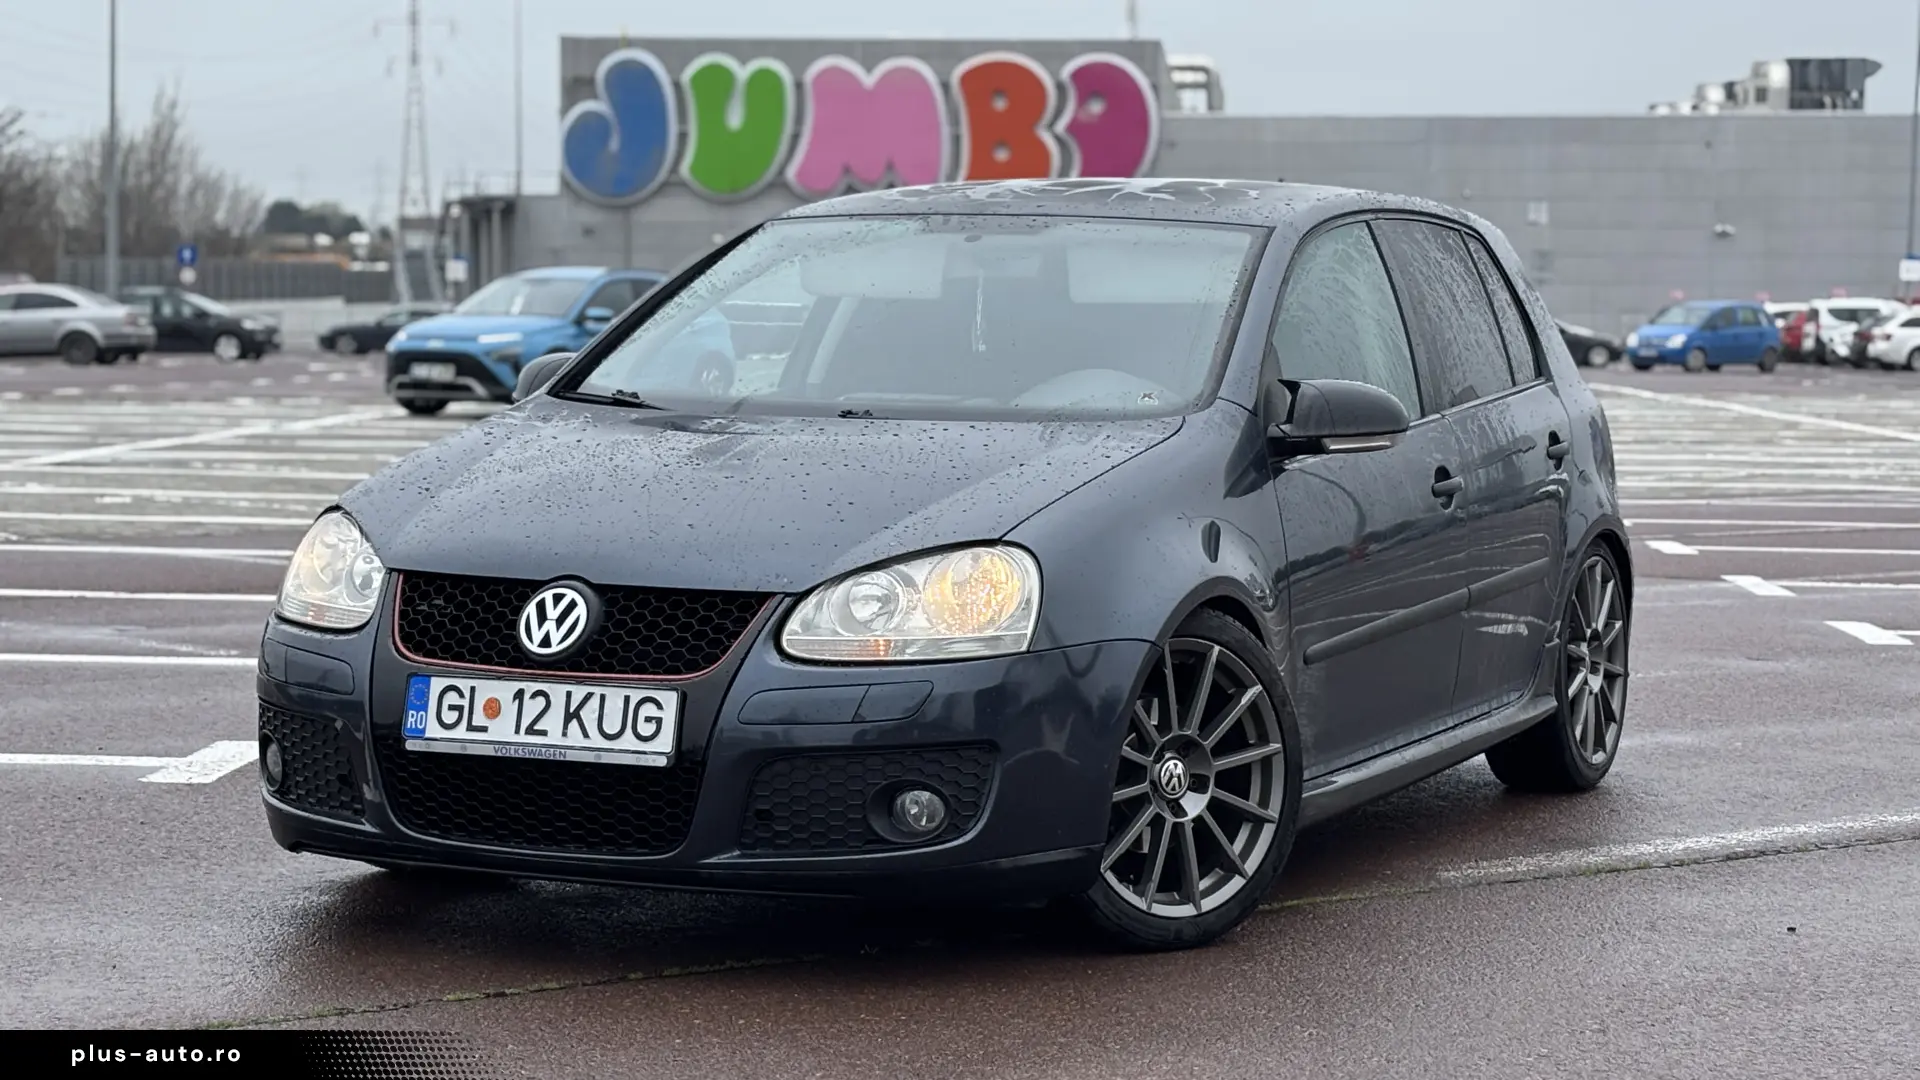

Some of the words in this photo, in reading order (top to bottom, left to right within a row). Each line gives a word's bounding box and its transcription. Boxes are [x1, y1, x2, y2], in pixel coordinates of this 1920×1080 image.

[561, 48, 1160, 206] JUMBO
[407, 710, 426, 730] RO
[435, 684, 490, 732] GL
[511, 687, 552, 737] 12
[561, 690, 665, 742] KUG
[492, 745, 568, 760] VOLKSWAGEN
